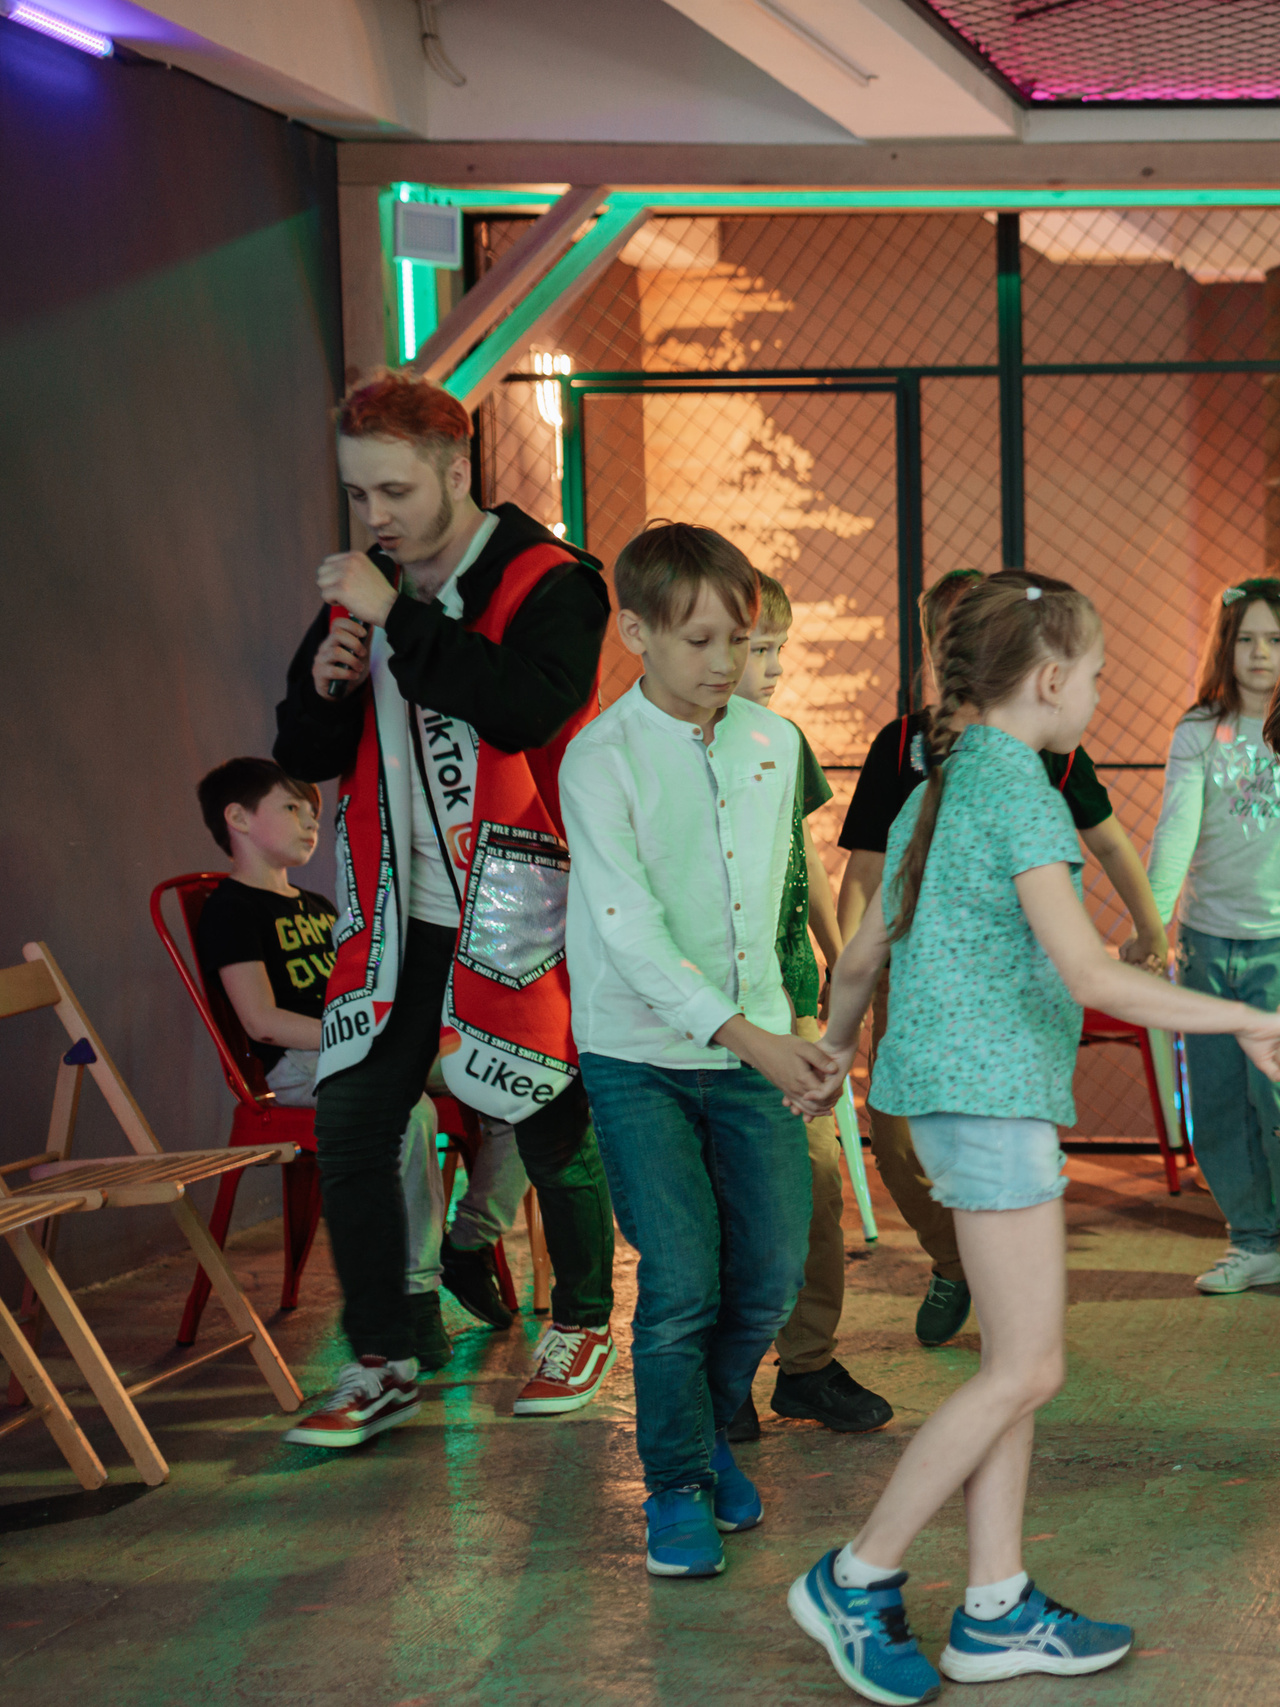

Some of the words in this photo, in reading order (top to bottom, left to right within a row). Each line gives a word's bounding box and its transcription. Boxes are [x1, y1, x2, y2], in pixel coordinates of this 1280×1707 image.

[422, 708, 472, 812] ikTok
[478, 821, 492, 848] SMILE
[512, 828, 538, 840] SMILE
[472, 849, 485, 875] SMILE
[505, 849, 533, 863] SMILE
[379, 860, 390, 886] SMILE
[375, 887, 386, 914] SMILE
[467, 875, 479, 902] SMILE
[349, 891, 361, 916] SMILE
[464, 901, 474, 927] SMILE
[275, 913, 337, 952] GAM
[373, 915, 382, 939] SMILE
[459, 928, 470, 953] SMILE
[368, 942, 381, 968] SMILE
[285, 951, 337, 989] OV
[473, 962, 499, 980] SMILE
[519, 966, 545, 987] SMILE
[465, 1024, 490, 1043] SMILE
[491, 1036, 518, 1055] SMILE
[518, 1048, 545, 1064] SMILE
[544, 1057, 569, 1072] SMILE
[465, 1048, 555, 1104] Likee
